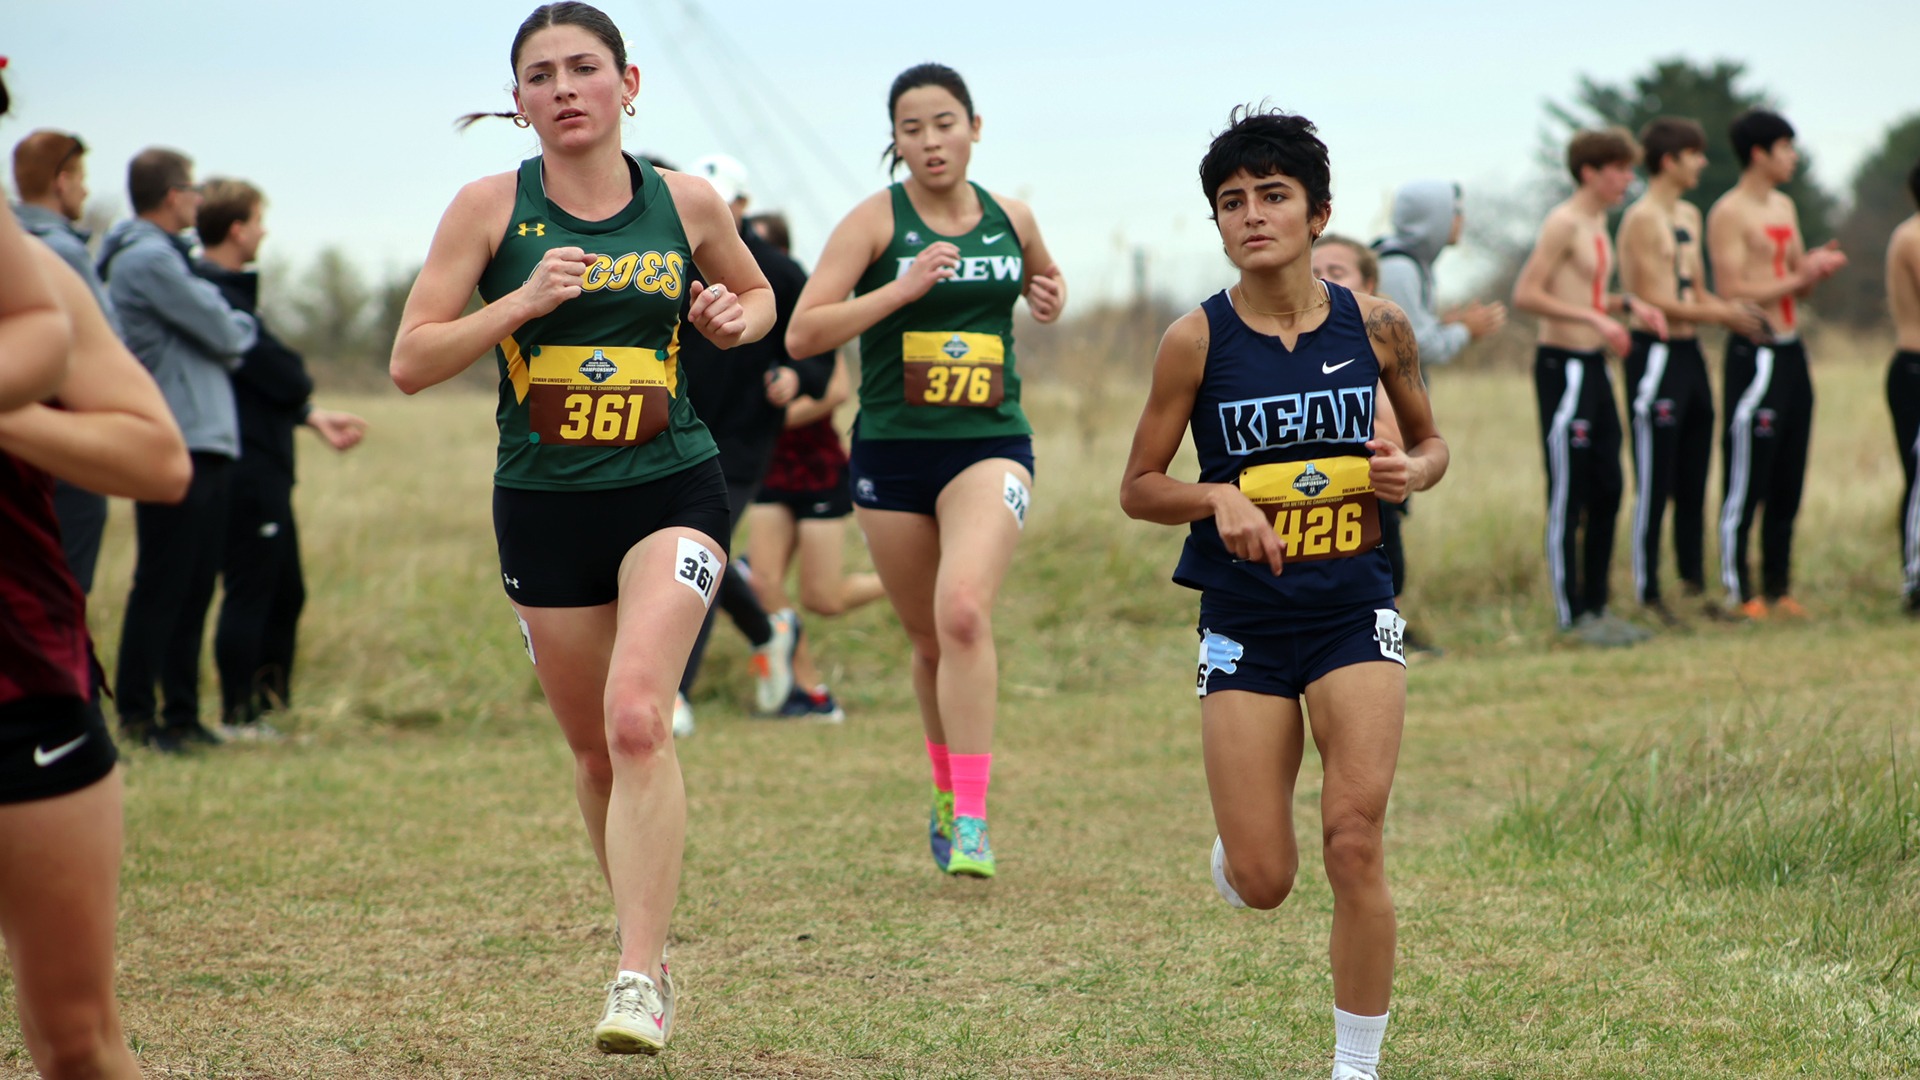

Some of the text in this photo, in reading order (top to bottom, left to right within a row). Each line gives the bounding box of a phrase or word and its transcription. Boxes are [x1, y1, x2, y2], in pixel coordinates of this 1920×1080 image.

[580, 251, 684, 300] GIES
[924, 365, 992, 404] 376
[560, 393, 644, 440] 361
[1218, 386, 1373, 456] KEAN
[1273, 503, 1362, 557] 426
[679, 556, 714, 598] 361
[1379, 626, 1406, 661] 42
